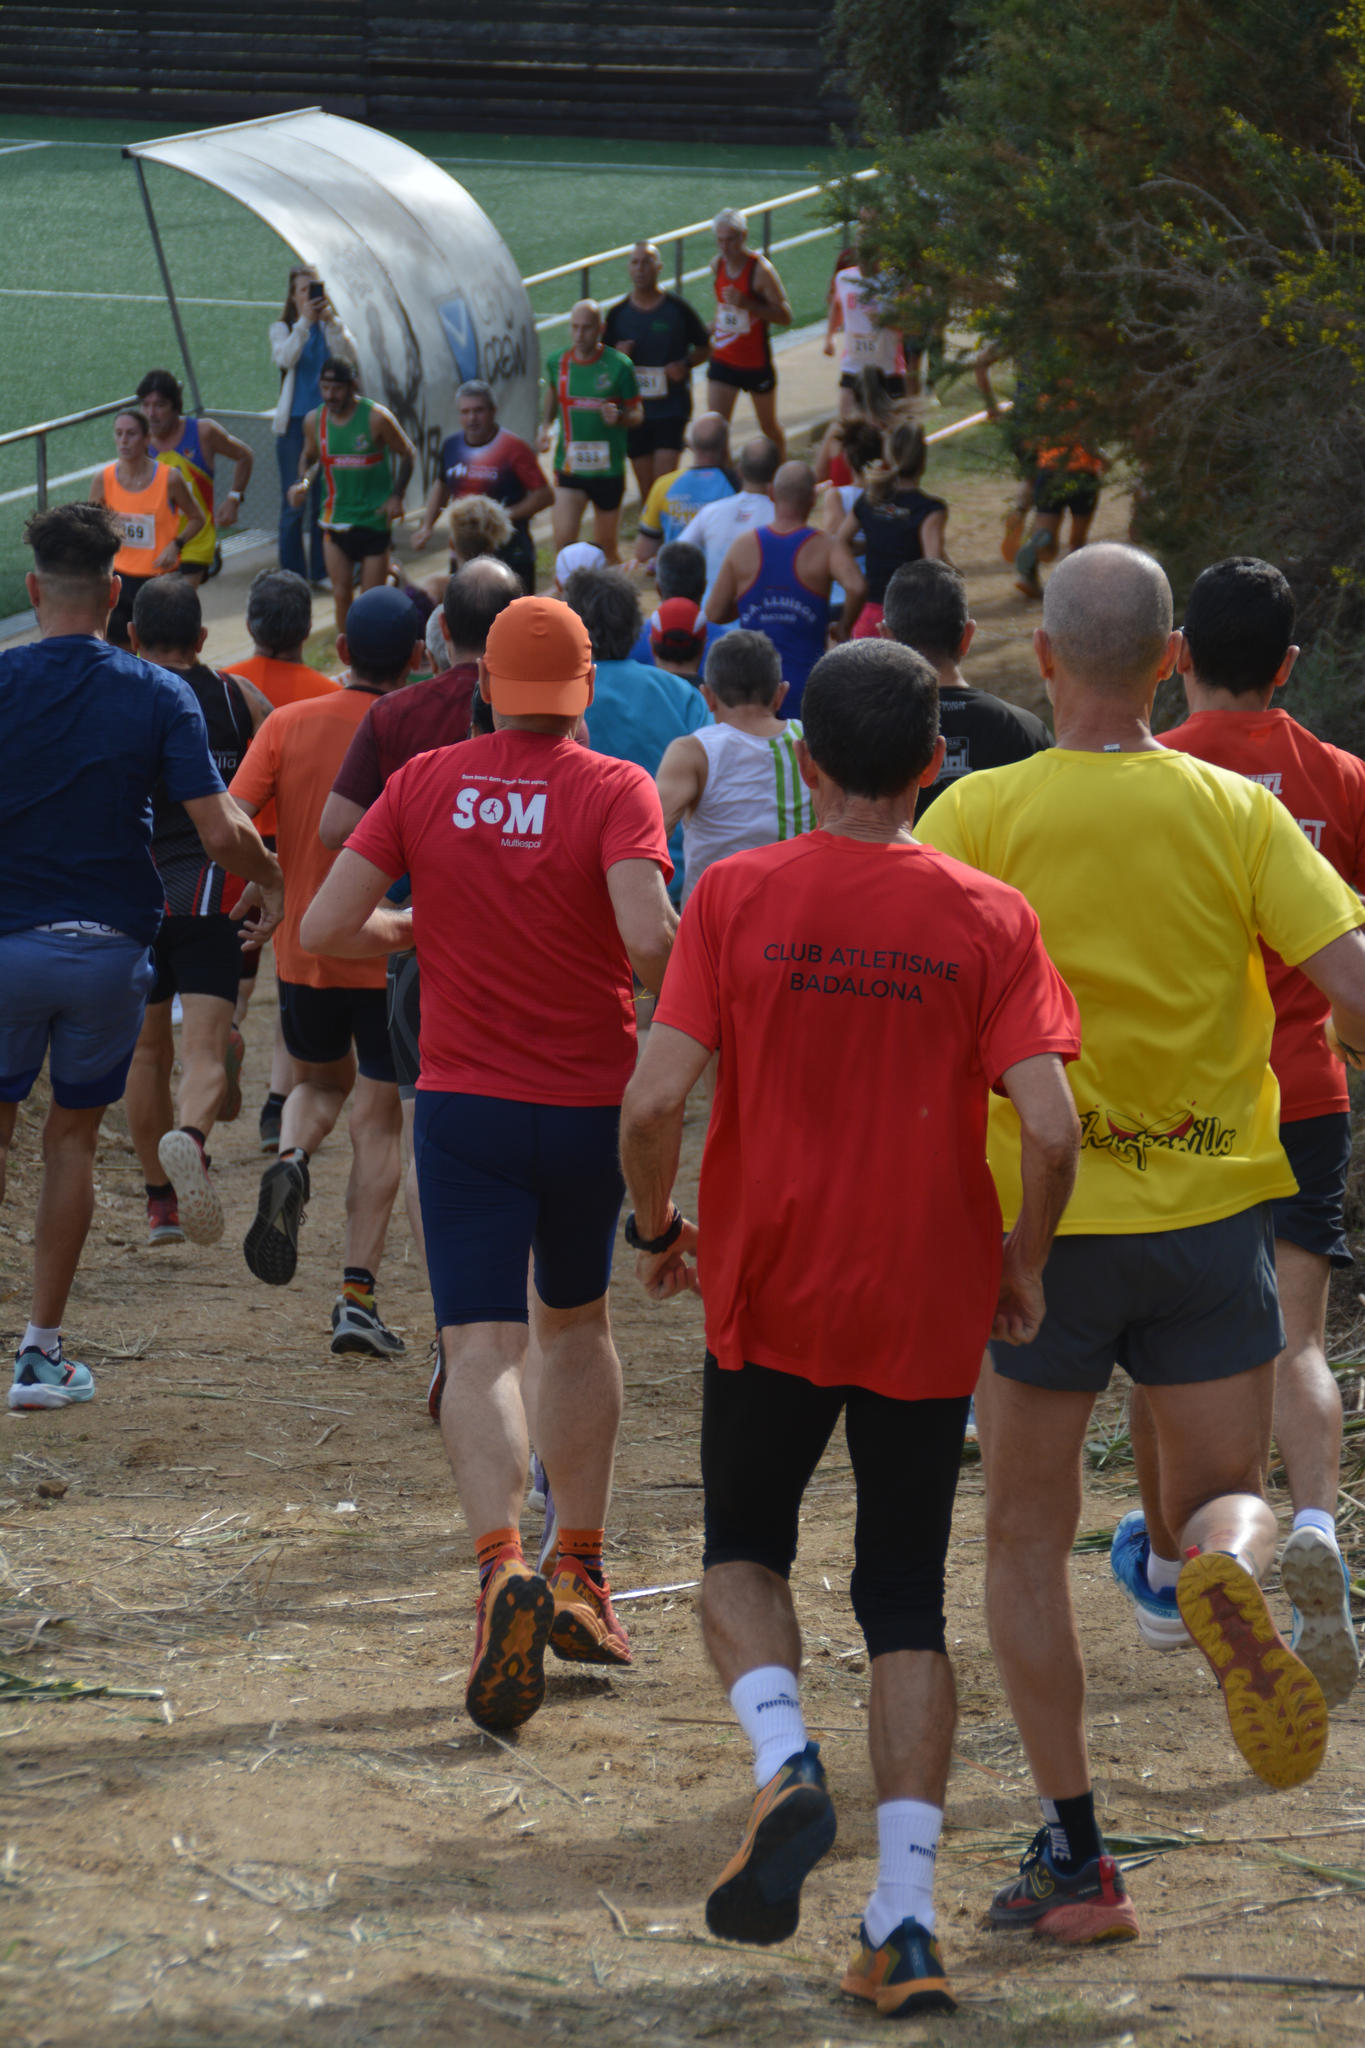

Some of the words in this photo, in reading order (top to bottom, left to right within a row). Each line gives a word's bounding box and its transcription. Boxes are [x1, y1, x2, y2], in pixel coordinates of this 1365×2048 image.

[452, 787, 547, 834] SOM
[763, 943, 823, 962] CLUB
[829, 947, 960, 982] ATLETISME
[790, 972, 923, 1004] BADALONA
